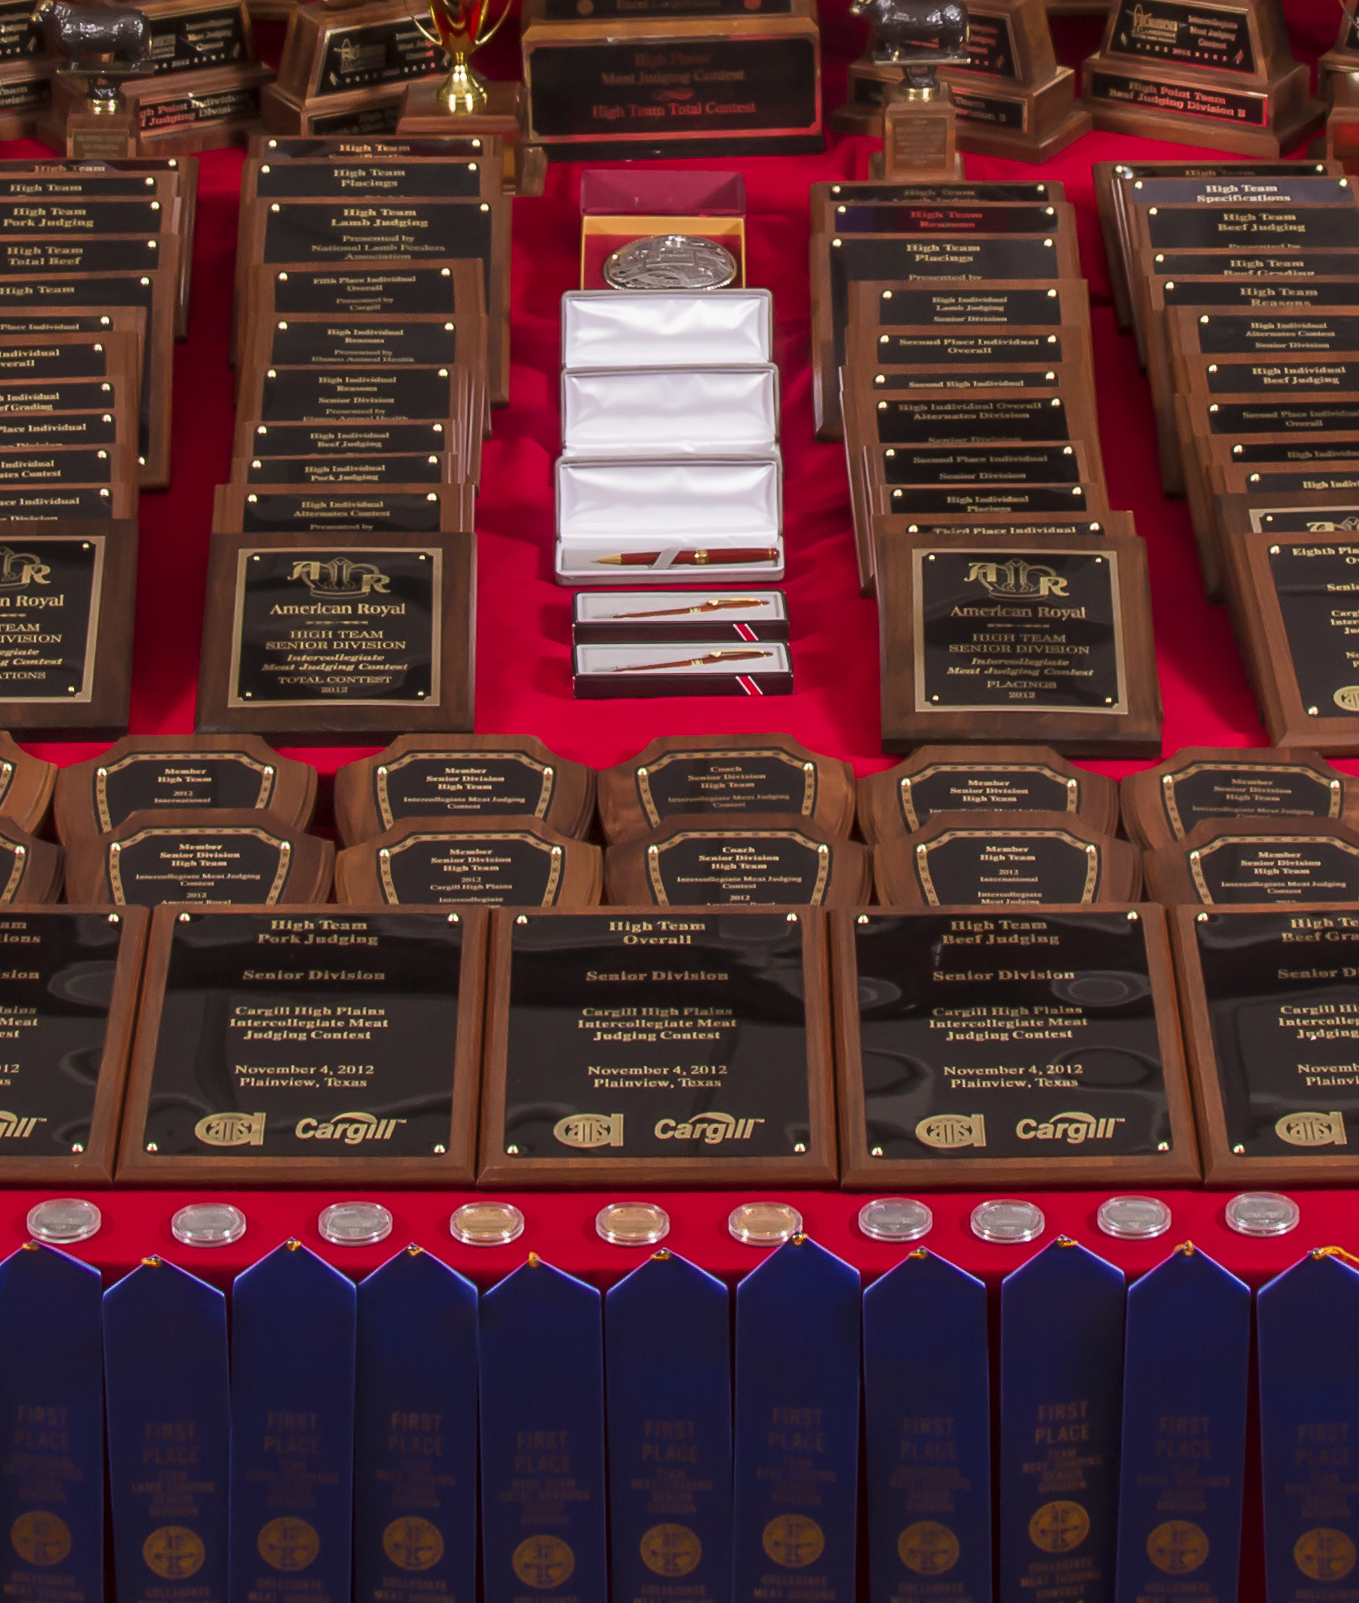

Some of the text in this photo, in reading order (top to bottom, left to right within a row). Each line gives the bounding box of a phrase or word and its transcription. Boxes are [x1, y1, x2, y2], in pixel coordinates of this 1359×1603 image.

[334, 169, 365, 178] High
[1206, 185, 1238, 193] High
[1197, 195, 1291, 203] Specifications
[14, 208, 46, 216] High
[38, 219, 93, 227] Judging
[1, 348, 59, 360] Individual
[16, 595, 64, 608] Royal
[272, 920, 367, 931] High Team
[610, 921, 705, 933] High Team
[952, 919, 1048, 932] High Team
[1291, 918, 1334, 929] High
[259, 934, 378, 945] Pork Judging
[624, 935, 691, 944] Overall
[944, 934, 1059, 945] Beef Judging
[1278, 932, 1321, 941] Beef
[586, 971, 728, 981] Senior Division
[582, 1008, 636, 1018] Cargill
[642, 1008, 679, 1017] High
[579, 1019, 735, 1029] Intercollegiate Meat
[593, 1031, 719, 1041] Judging Contest
[587, 1065, 729, 1077] November 4, 2012
[595, 1078, 721, 1088] Plainview, Texas
[655, 1112, 756, 1143] Cargill
[1016, 1112, 1119, 1143] Cargill
[1039, 1402, 1088, 1422] FIRST
[1035, 1422, 1090, 1444] PLACE
